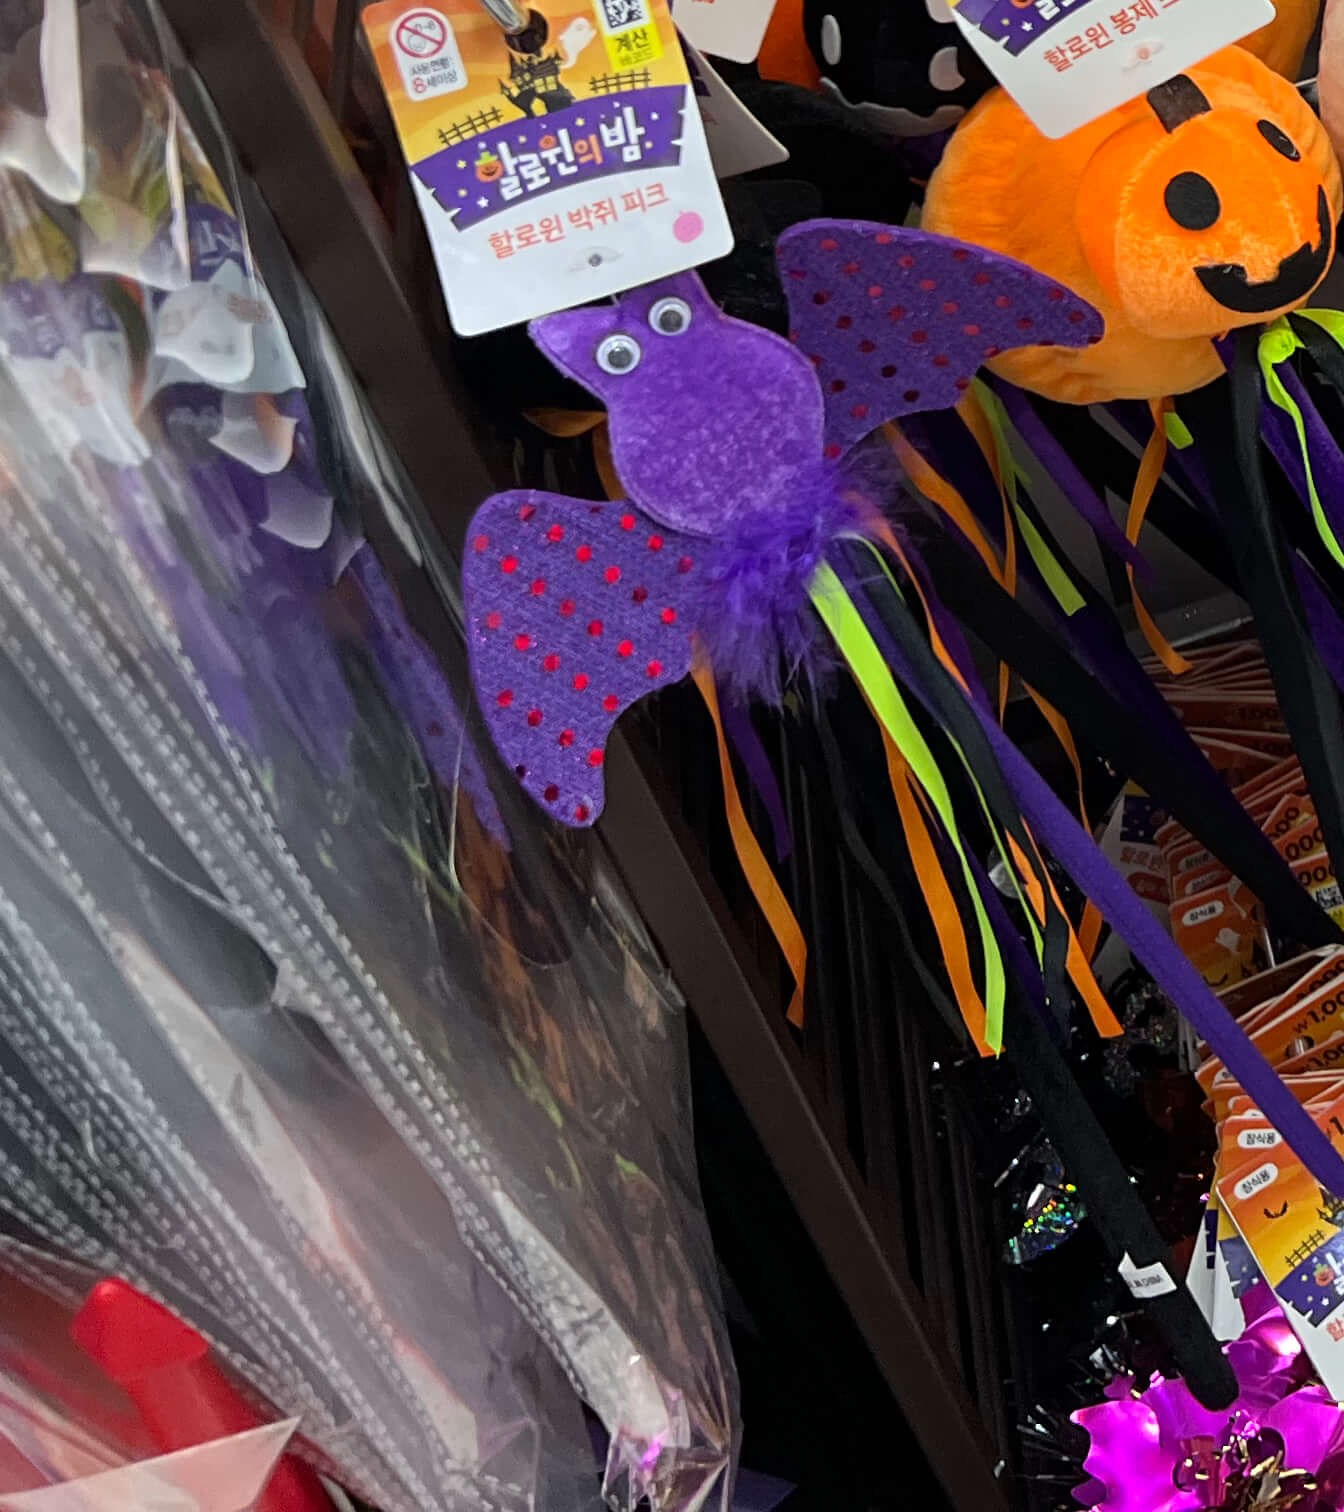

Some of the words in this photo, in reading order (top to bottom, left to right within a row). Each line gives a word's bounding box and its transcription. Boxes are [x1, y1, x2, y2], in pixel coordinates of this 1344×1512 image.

[613, 30, 650, 54] 계산
[1043, 23, 1115, 73] 할로윈
[1109, 2, 1157, 40] 봉제
[600, 105, 646, 163] 밤
[487, 215, 567, 261] 할로윈
[568, 196, 620, 233] 박쥐
[622, 182, 671, 213] 피크
